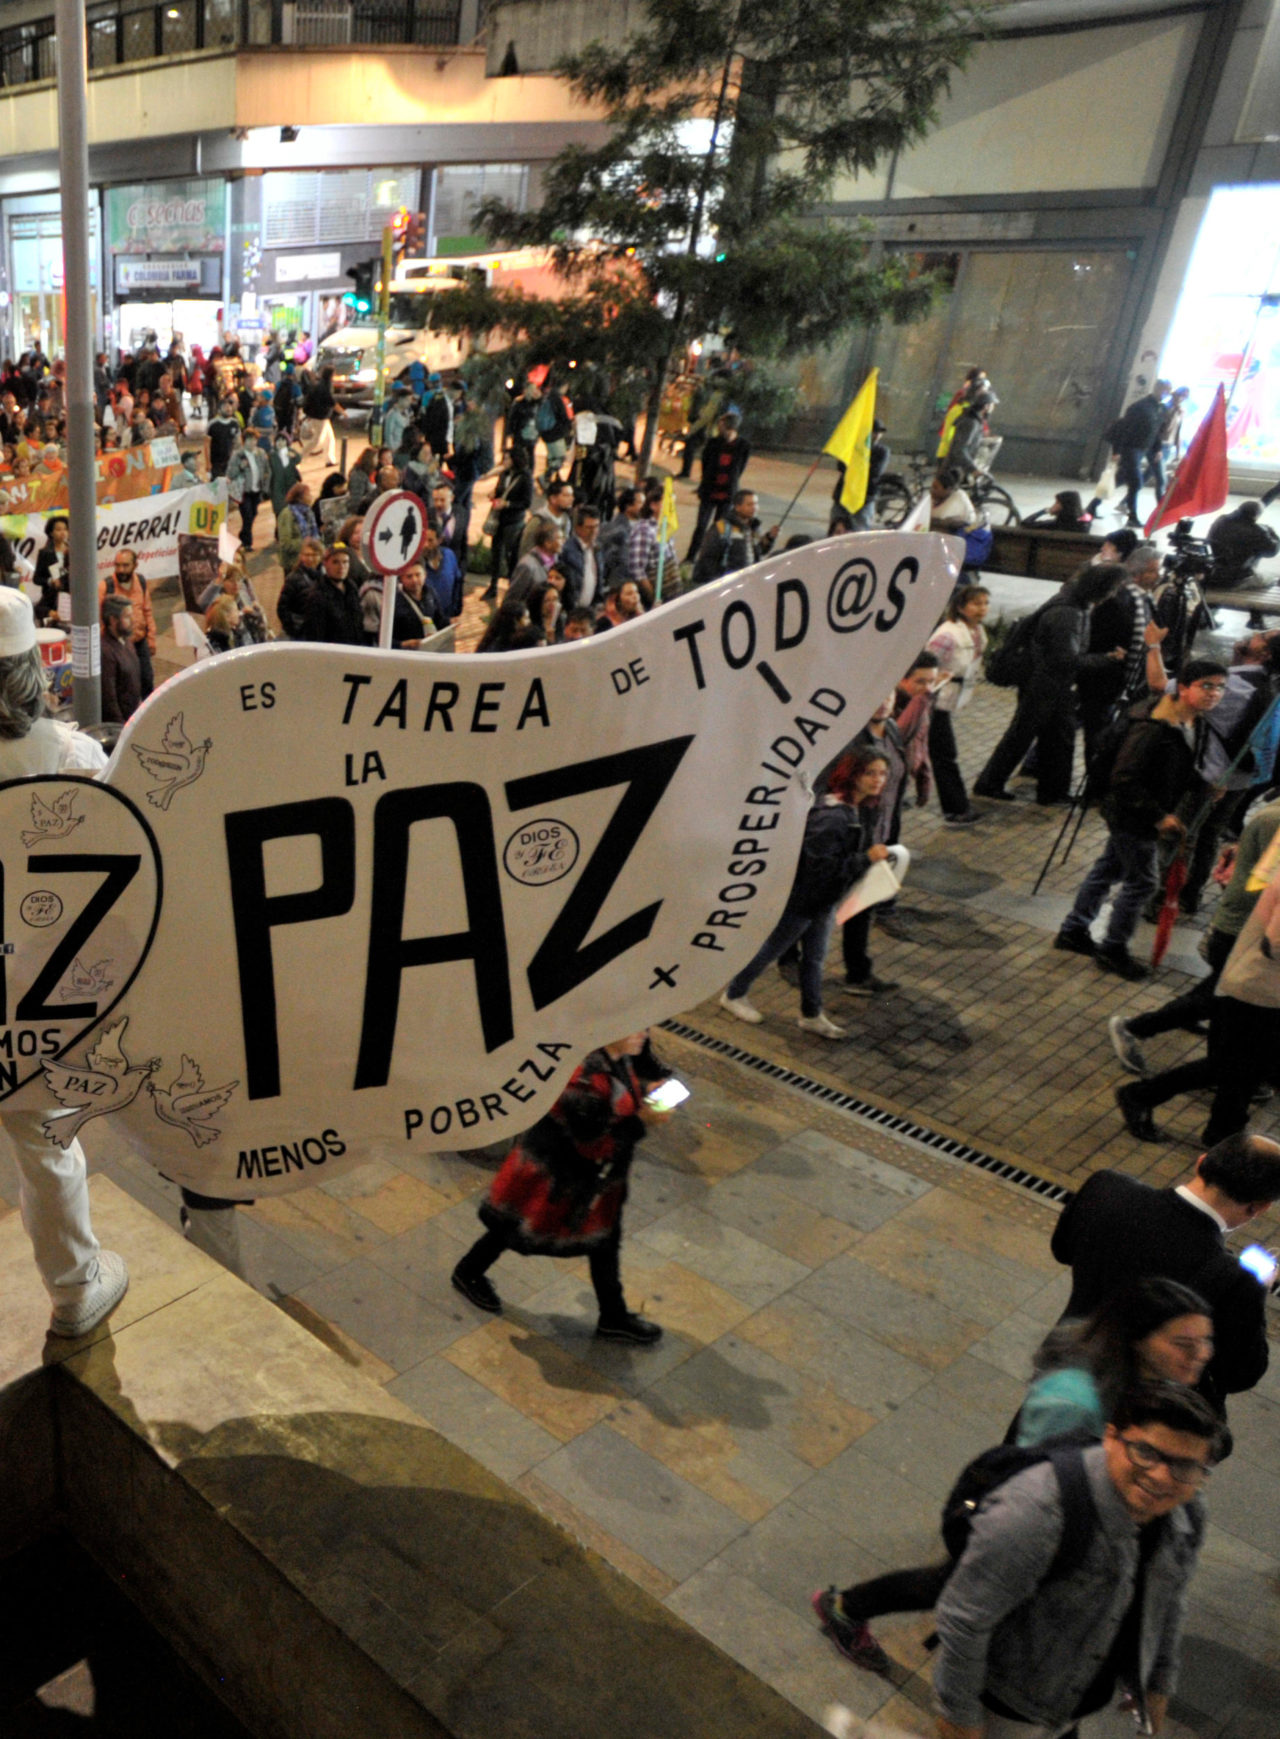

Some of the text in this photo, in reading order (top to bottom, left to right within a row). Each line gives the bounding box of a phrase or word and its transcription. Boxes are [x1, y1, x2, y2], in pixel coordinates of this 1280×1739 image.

[97, 510, 182, 550] GUERRA!
[240, 556, 919, 734] ES TAREA DE TOD@S
[345, 750, 387, 785] LA
[520, 826, 561, 846] DIOS
[690, 687, 847, 954] PROSPERIDAD
[31, 895, 55, 903] DIOS
[224, 734, 696, 1102] PAZ
[64, 1076, 108, 1096] PAZ
[236, 1042, 573, 1180] MENOS POBREZA
